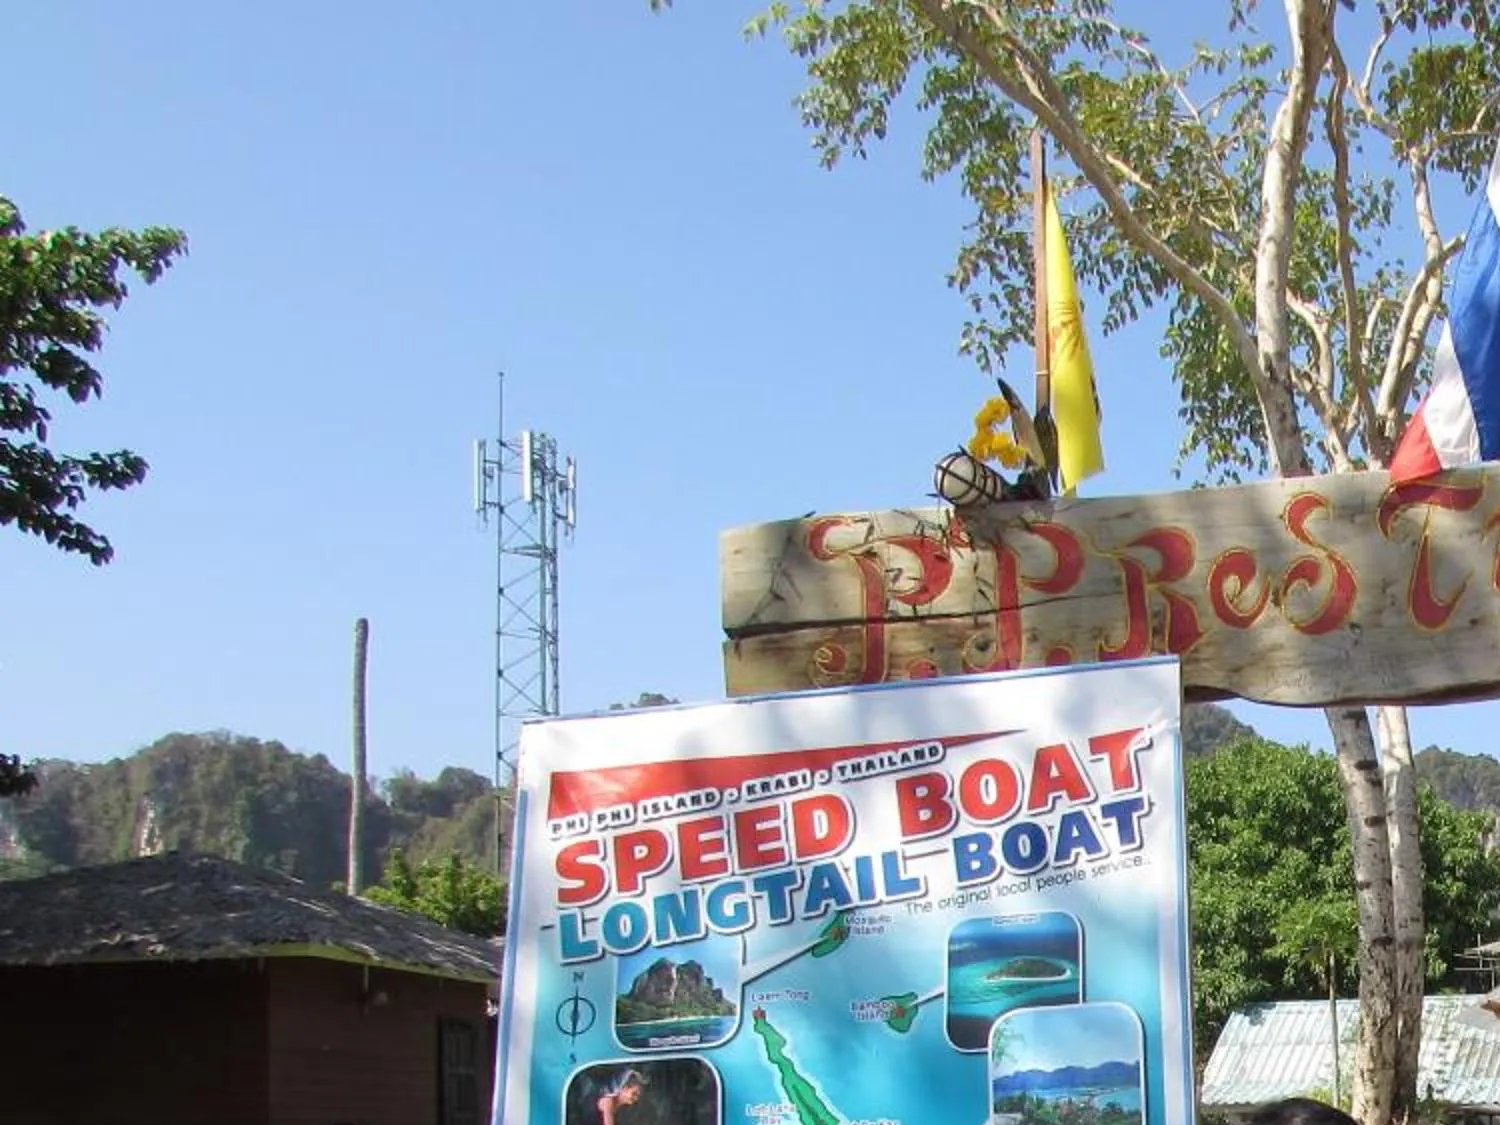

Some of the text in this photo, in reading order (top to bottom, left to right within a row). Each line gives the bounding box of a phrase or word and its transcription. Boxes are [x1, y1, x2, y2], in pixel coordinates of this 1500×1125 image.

[552, 745, 940, 835] PHI PHI ISLAND KRABI THAILAND
[554, 727, 1148, 905] SPEED BOAT
[559, 799, 1146, 959] LONGTAIL BOAT
[906, 901, 933, 915] The
[938, 886, 992, 908] original
[997, 878, 1031, 897] local
[1036, 868, 1086, 892] people
[573, 971, 584, 982] N
